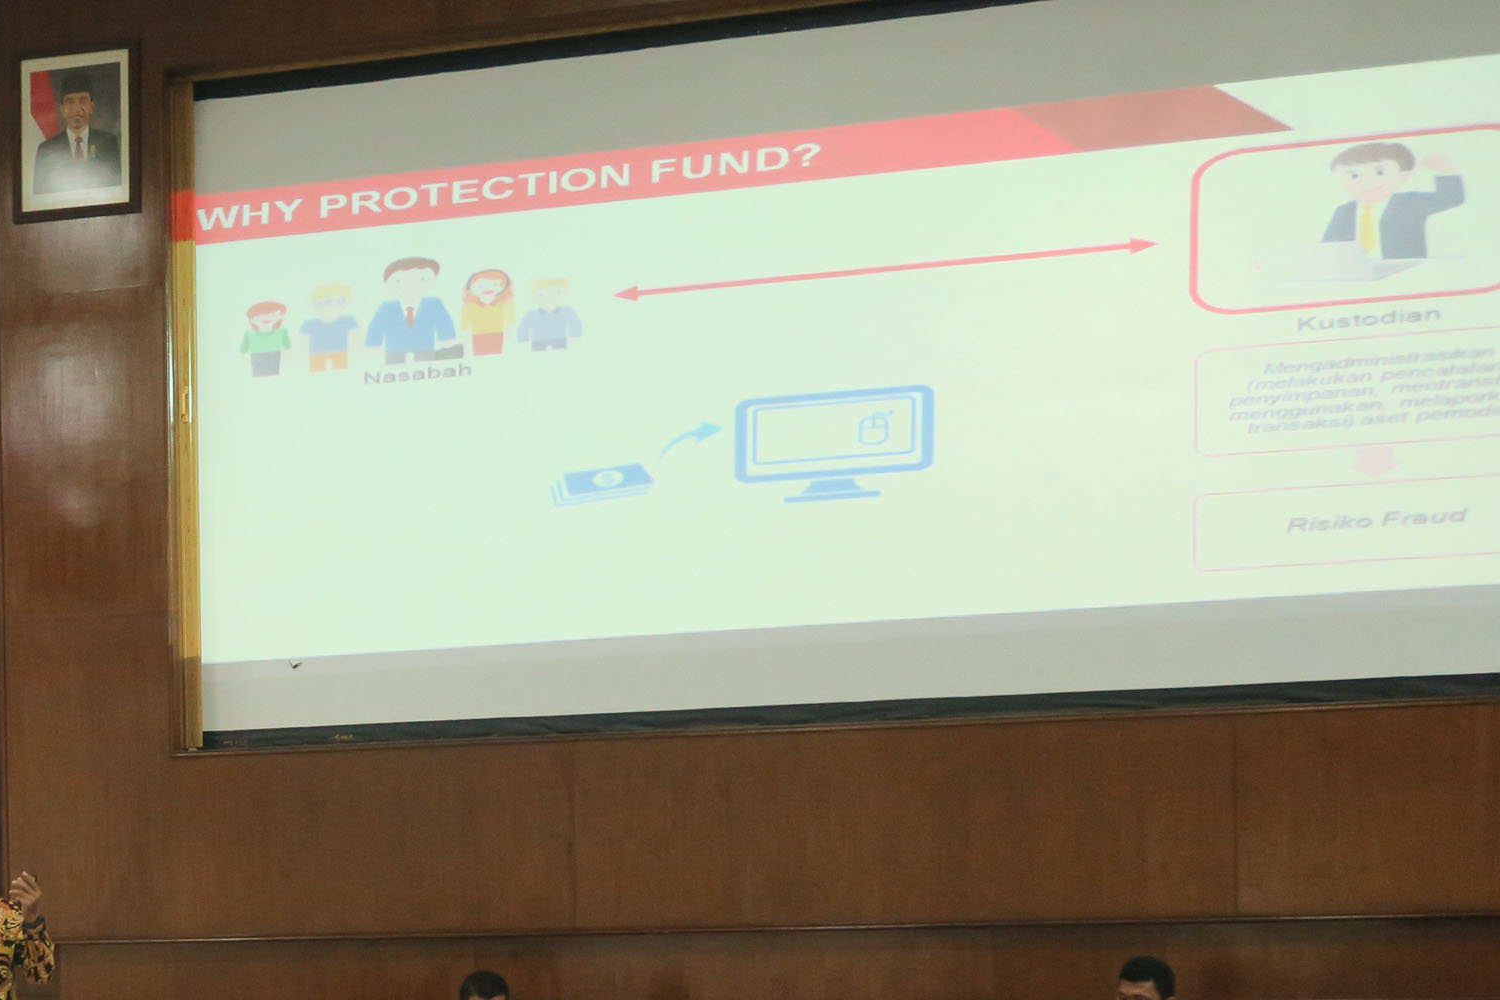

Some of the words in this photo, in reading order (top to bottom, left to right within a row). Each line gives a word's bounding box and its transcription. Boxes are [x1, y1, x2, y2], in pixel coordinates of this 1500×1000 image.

[197, 198, 304, 231] WHY
[319, 163, 631, 219] PROTECTION
[651, 143, 823, 182] FUND?
[1297, 307, 1443, 332] Kustodian
[363, 364, 473, 385] Nasabah
[1286, 513, 1373, 534] Risiko
[1380, 507, 1469, 529] Fraud
